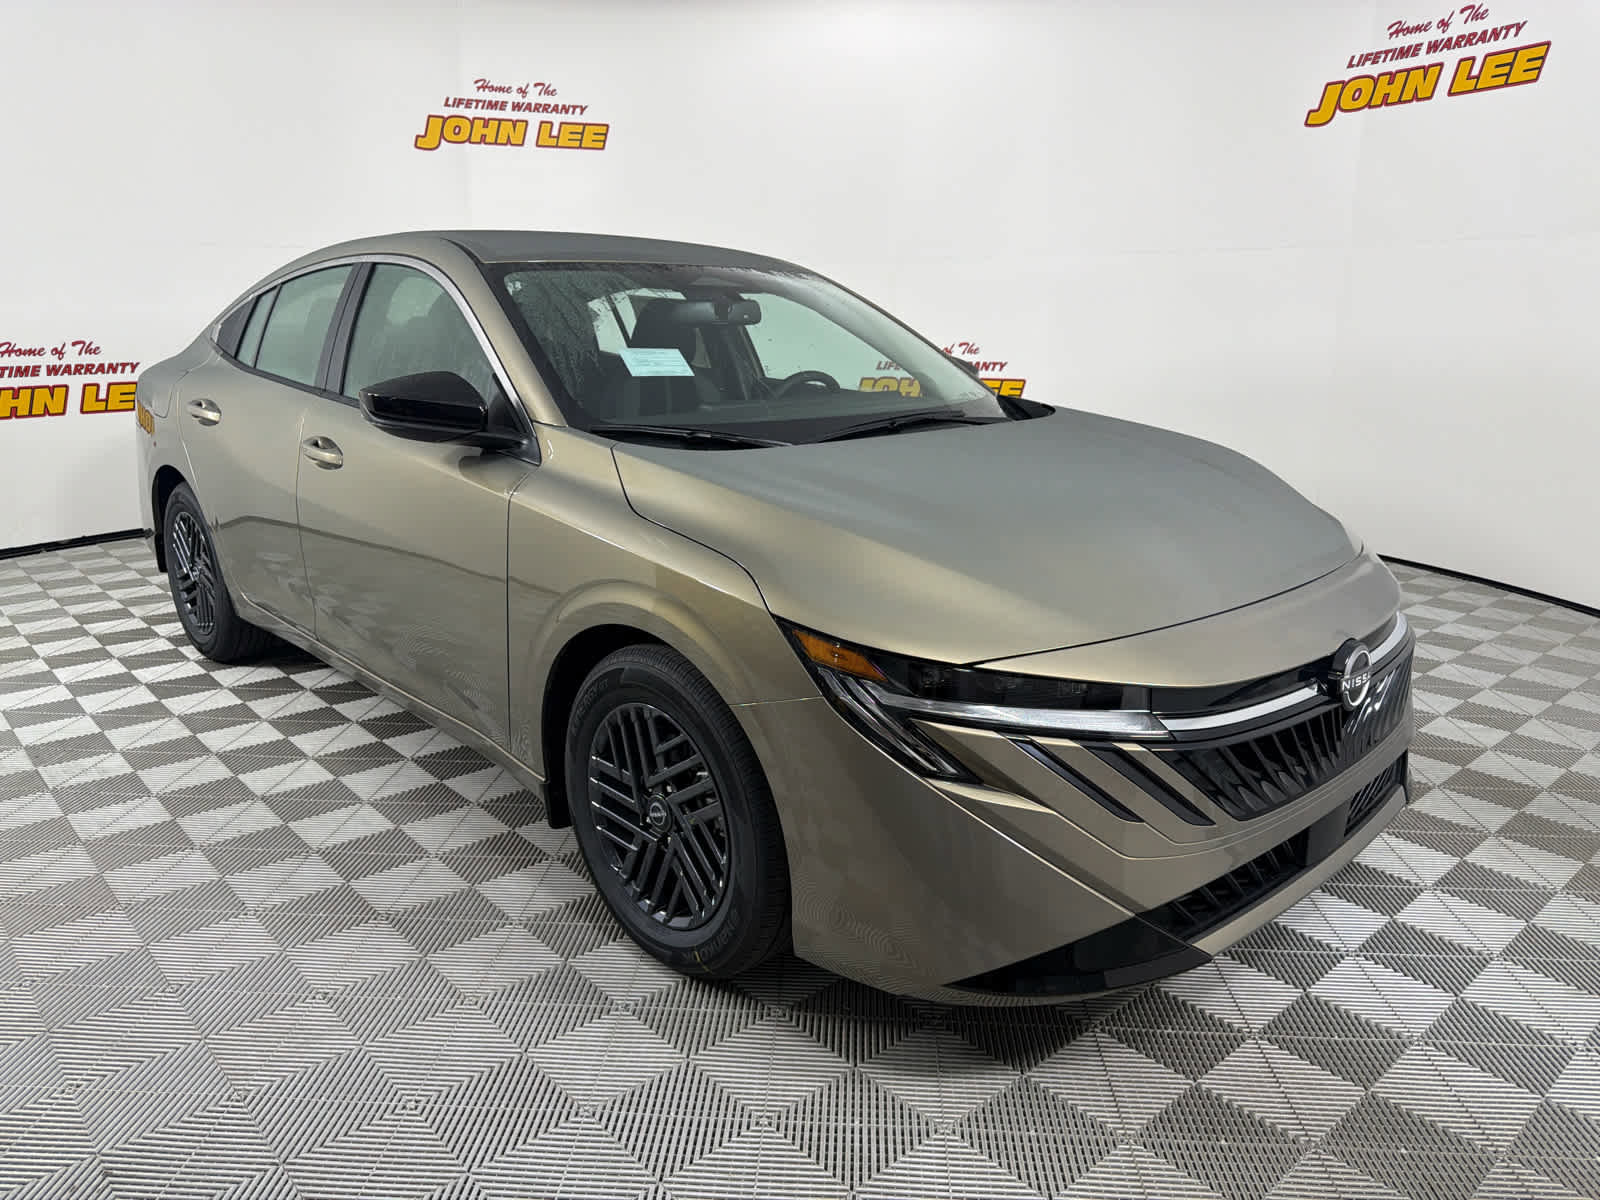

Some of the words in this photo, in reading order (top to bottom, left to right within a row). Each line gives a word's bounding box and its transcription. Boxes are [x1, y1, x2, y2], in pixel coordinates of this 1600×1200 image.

[1387, 20, 1432, 40] Home
[1437, 11, 1454, 33] of
[1459, 2, 1489, 24] The
[1346, 42, 1424, 69] LIFETIME
[1426, 20, 1528, 55] WARRANTY
[473, 78, 513, 95] Home
[516, 83, 530, 98] of
[533, 82, 557, 97] The
[1304, 62, 1444, 127] JOHN
[1448, 40, 1552, 96] LEE
[444, 97, 507, 111] LIFETIME
[511, 101, 588, 115] WARRANTY
[414, 115, 528, 151] JOHN
[536, 121, 609, 150] LEE
[0, 341, 46, 358] Home
[50, 342, 66, 360] of
[71, 340, 101, 356] The
[959, 342, 979, 355] The
[0, 365, 41, 378] TIME
[46, 362, 140, 377] WARRANTY
[0, 384, 69, 419] HN
[80, 381, 138, 414] LE
